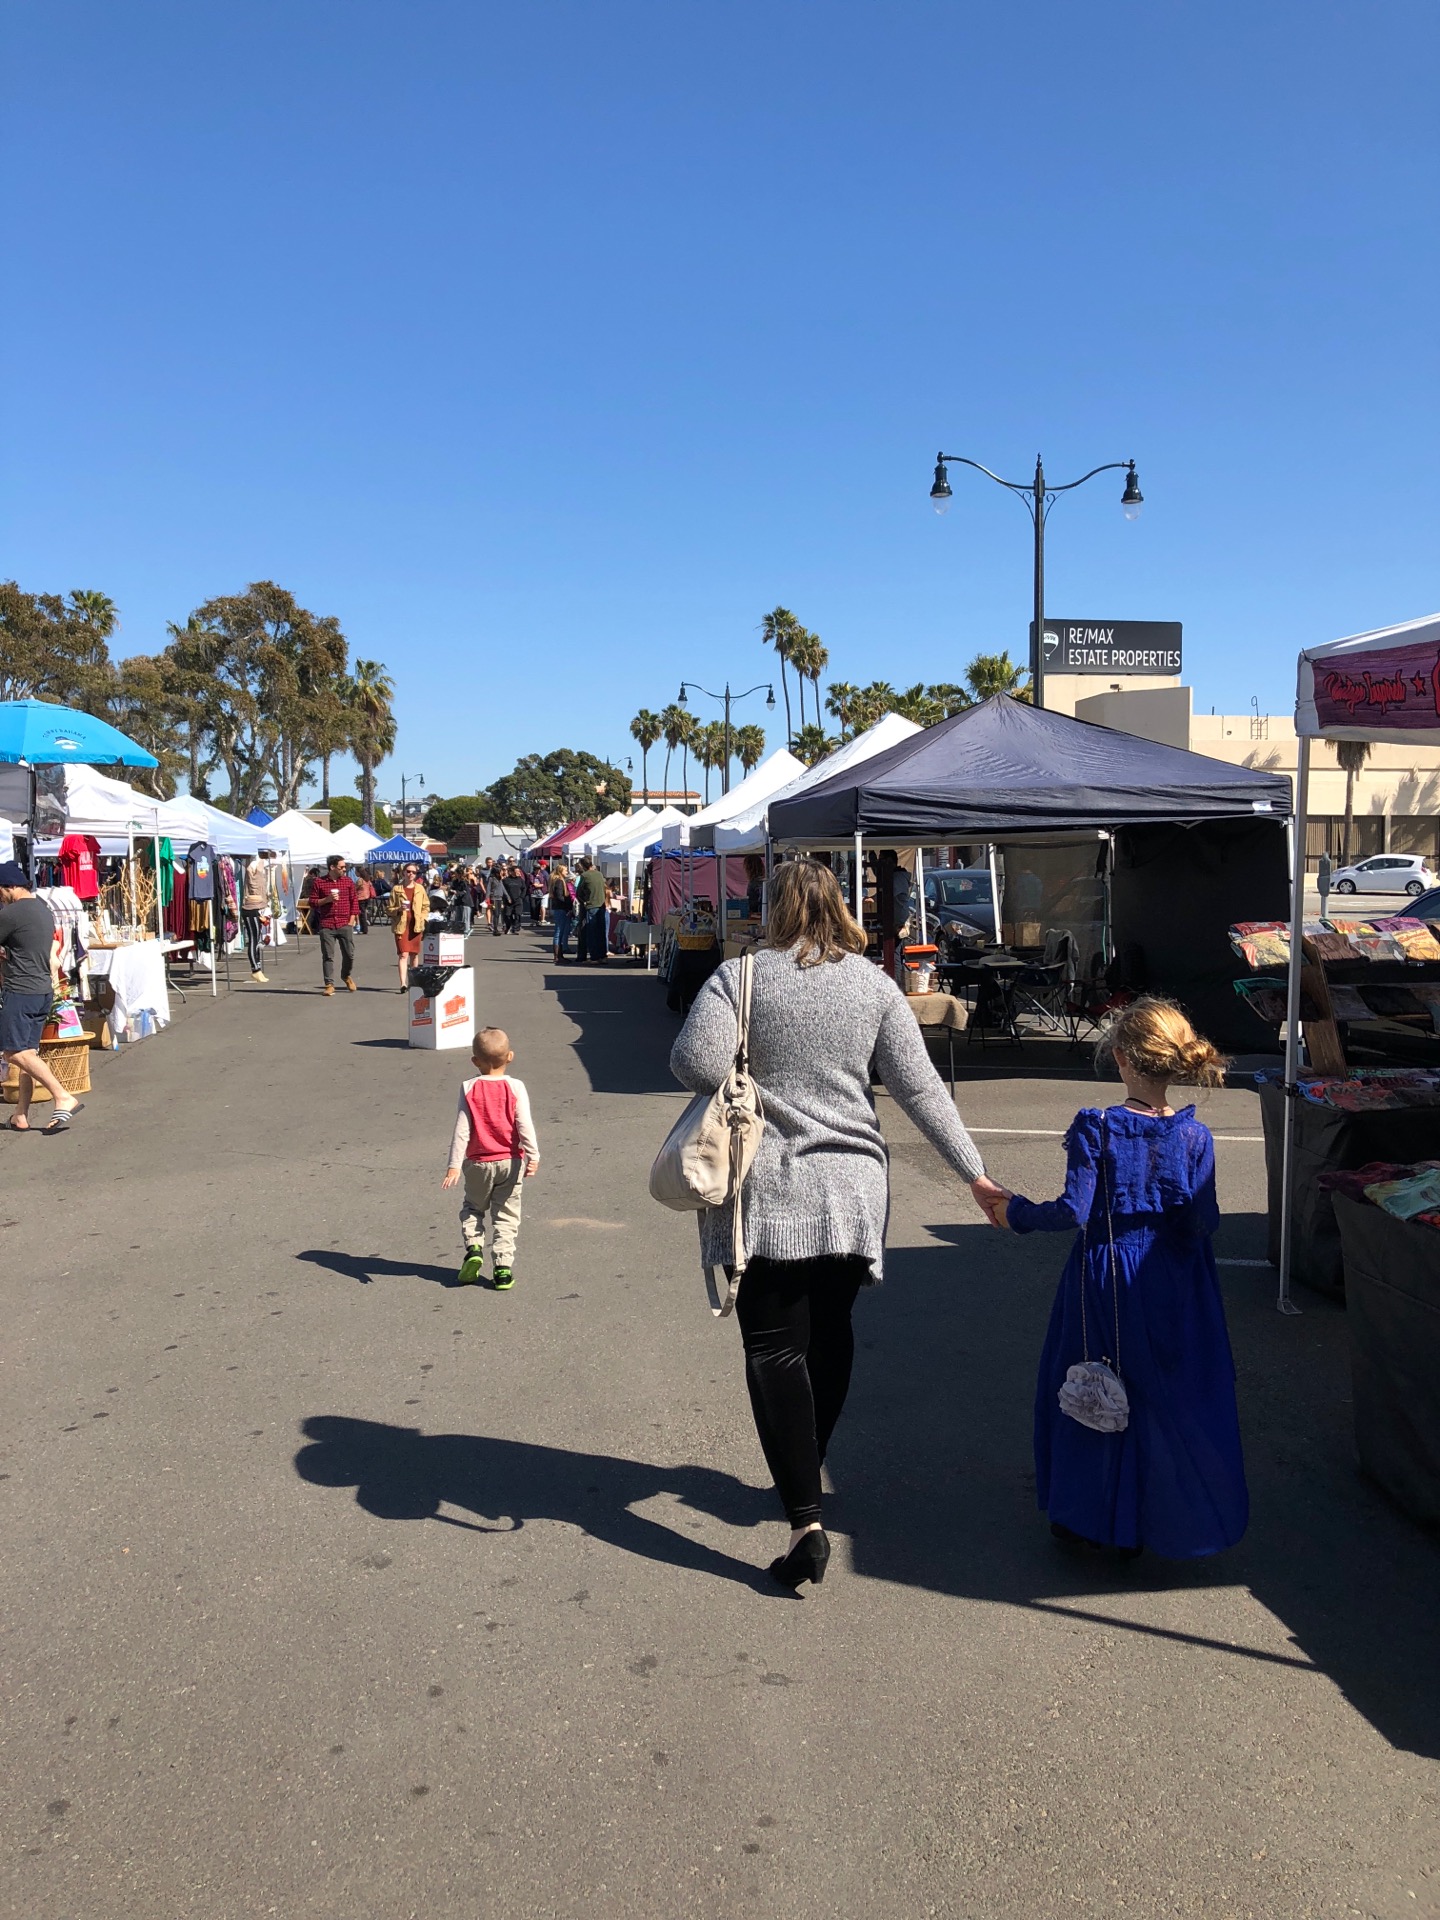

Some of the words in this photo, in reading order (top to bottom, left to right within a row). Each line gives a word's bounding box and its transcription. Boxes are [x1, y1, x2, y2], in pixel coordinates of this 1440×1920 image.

[1068, 627, 1114, 645] RE/MAX
[1068, 649, 1108, 666] ESTATE
[1111, 650, 1181, 667] PROPERTIES
[369, 850, 424, 861] INFORMATION
